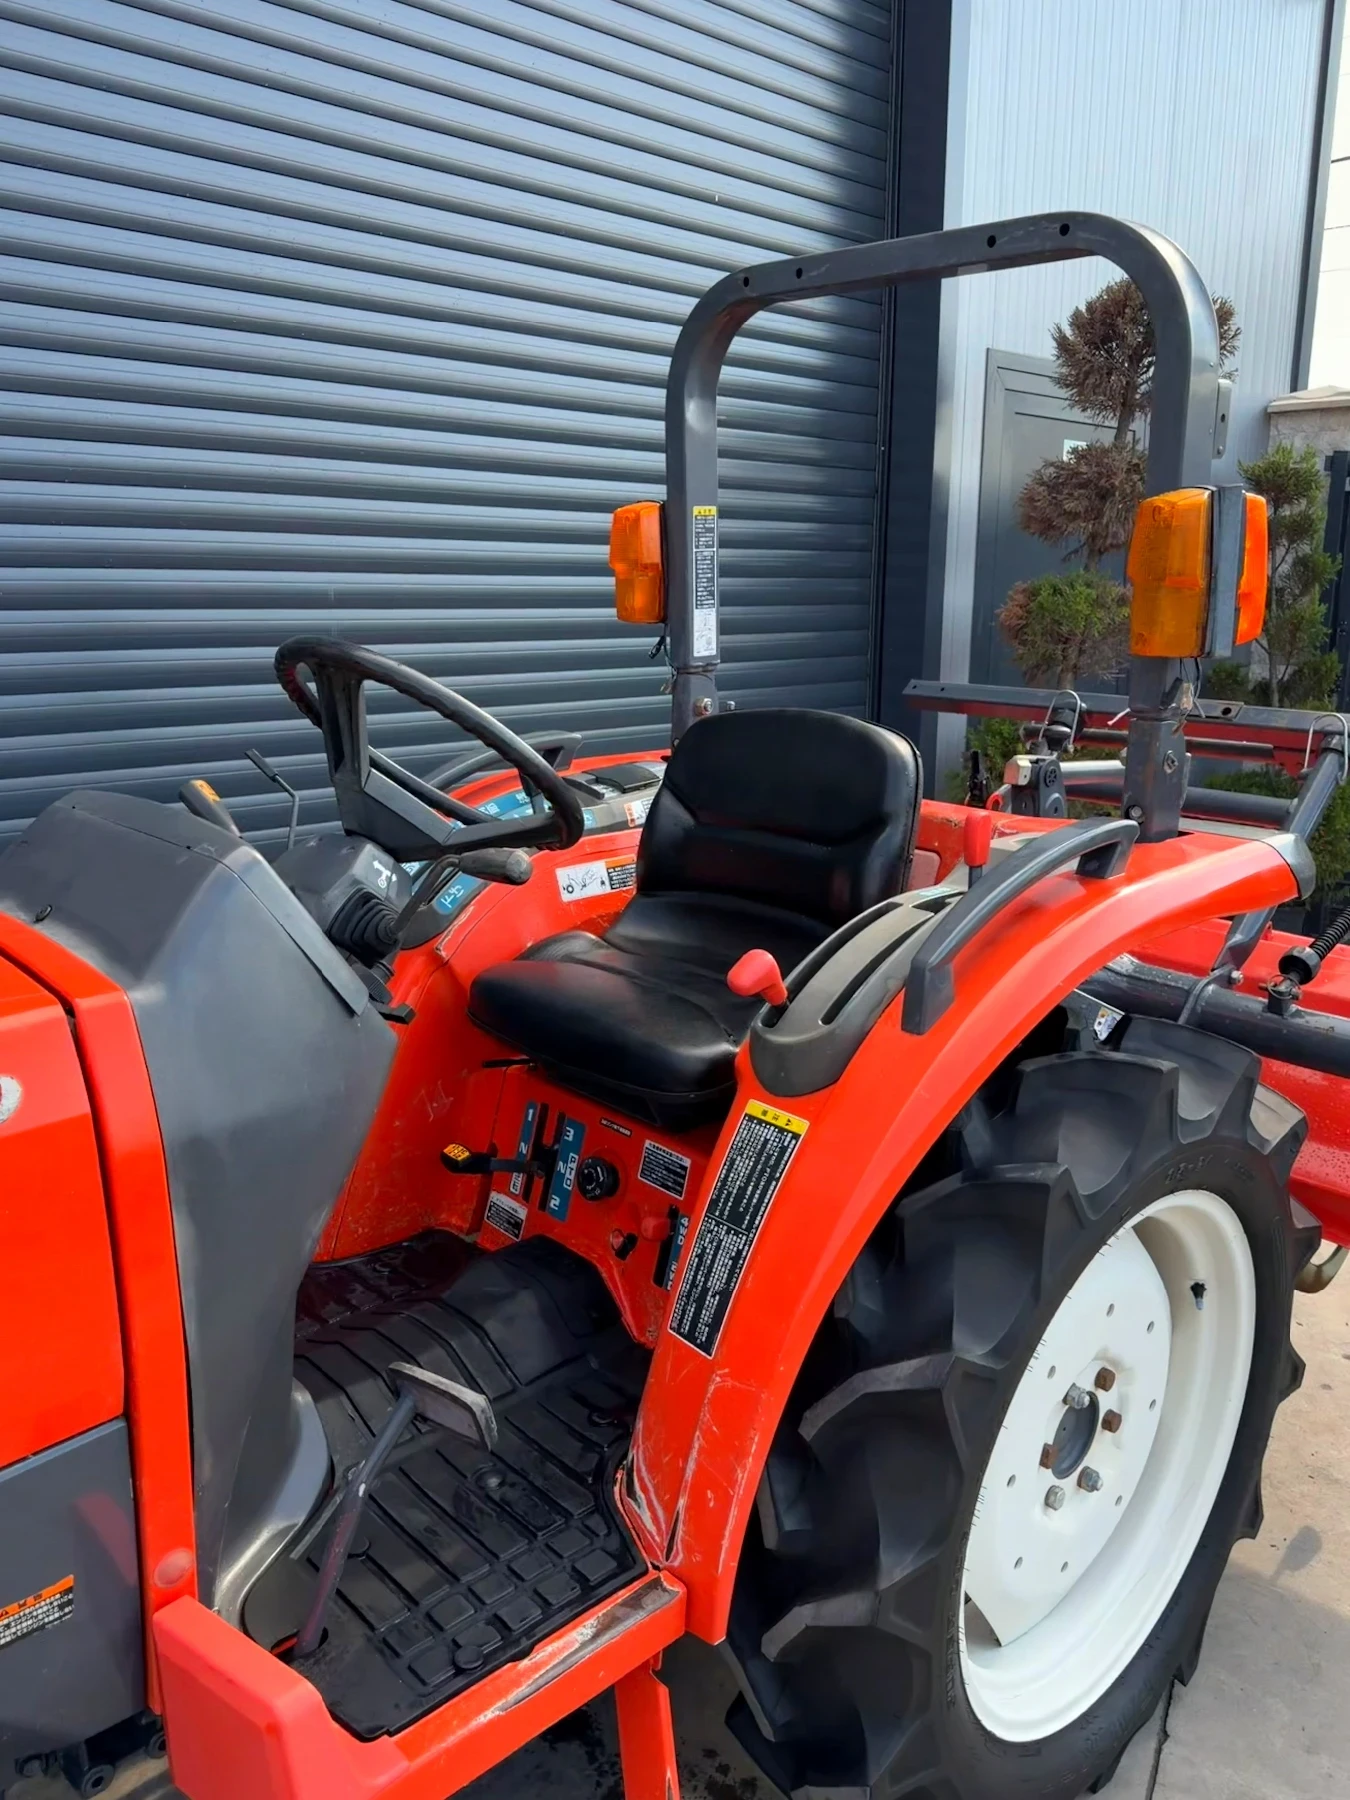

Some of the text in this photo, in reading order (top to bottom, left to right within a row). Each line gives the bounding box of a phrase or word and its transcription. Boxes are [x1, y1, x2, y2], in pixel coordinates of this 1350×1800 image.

[527, 1108, 533, 1122] 1
[563, 1126, 574, 1142] 3
[519, 1142, 528, 1155] N
[557, 1160, 567, 1174] N
[549, 1195, 561, 1210] 2
[678, 1217, 689, 1245] 4WD
